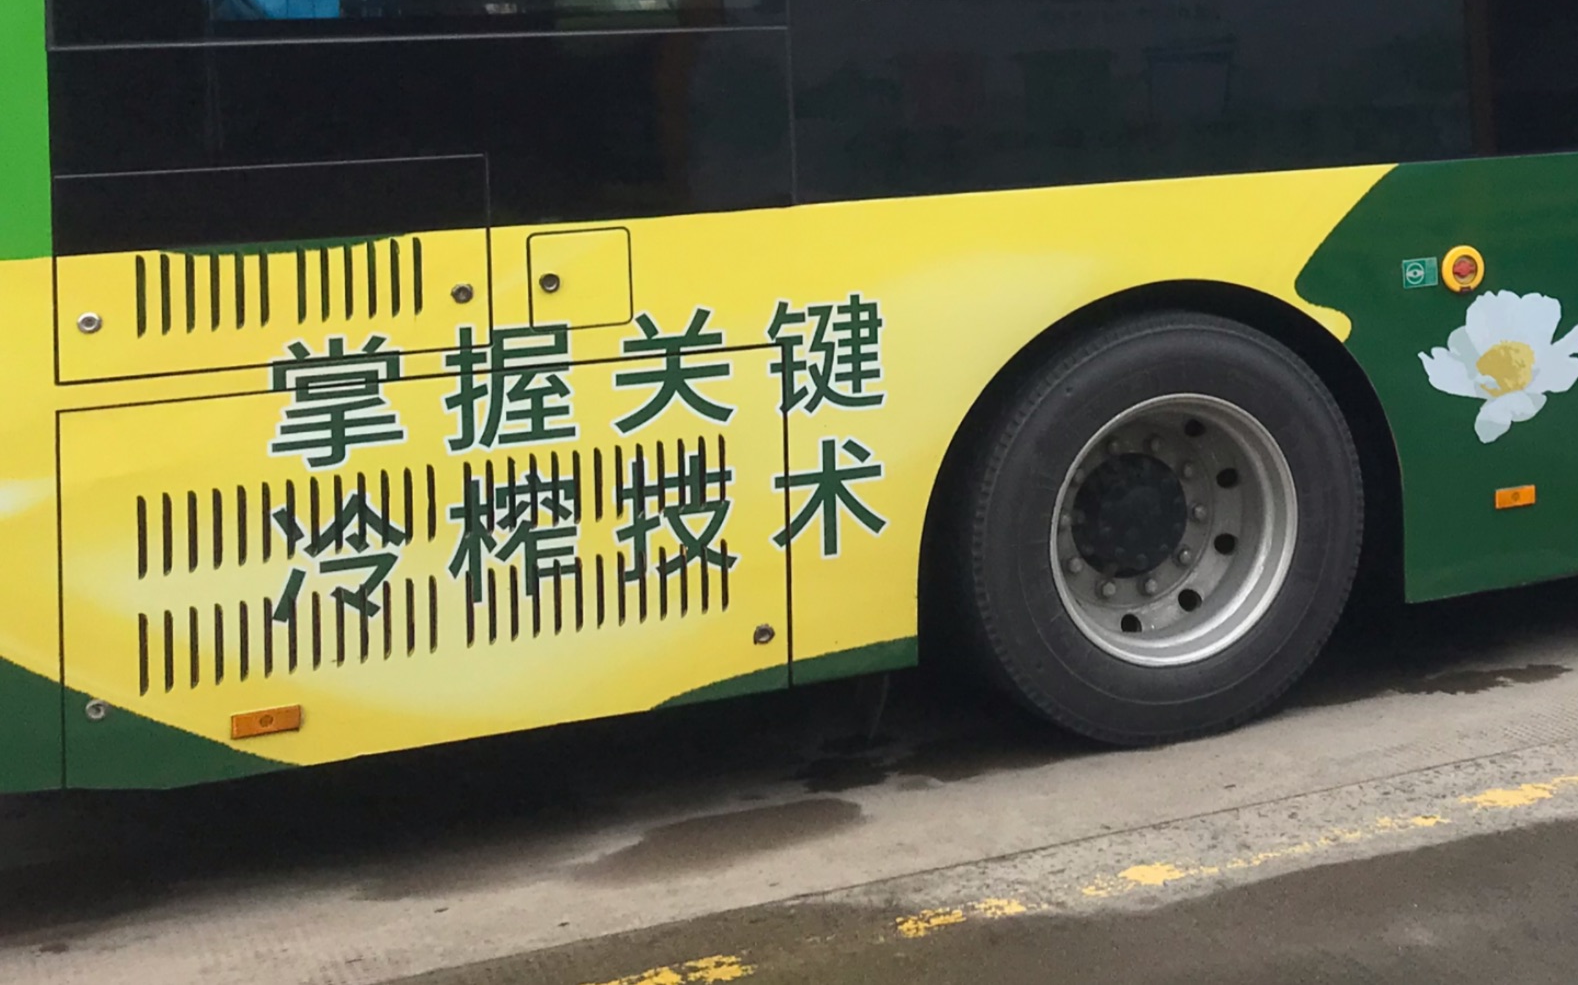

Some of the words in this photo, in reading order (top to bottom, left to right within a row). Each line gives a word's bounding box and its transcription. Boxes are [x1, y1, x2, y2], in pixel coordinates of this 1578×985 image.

[269, 293, 885, 468] 掌握关键
[269, 437, 887, 623] 冷榨技术
